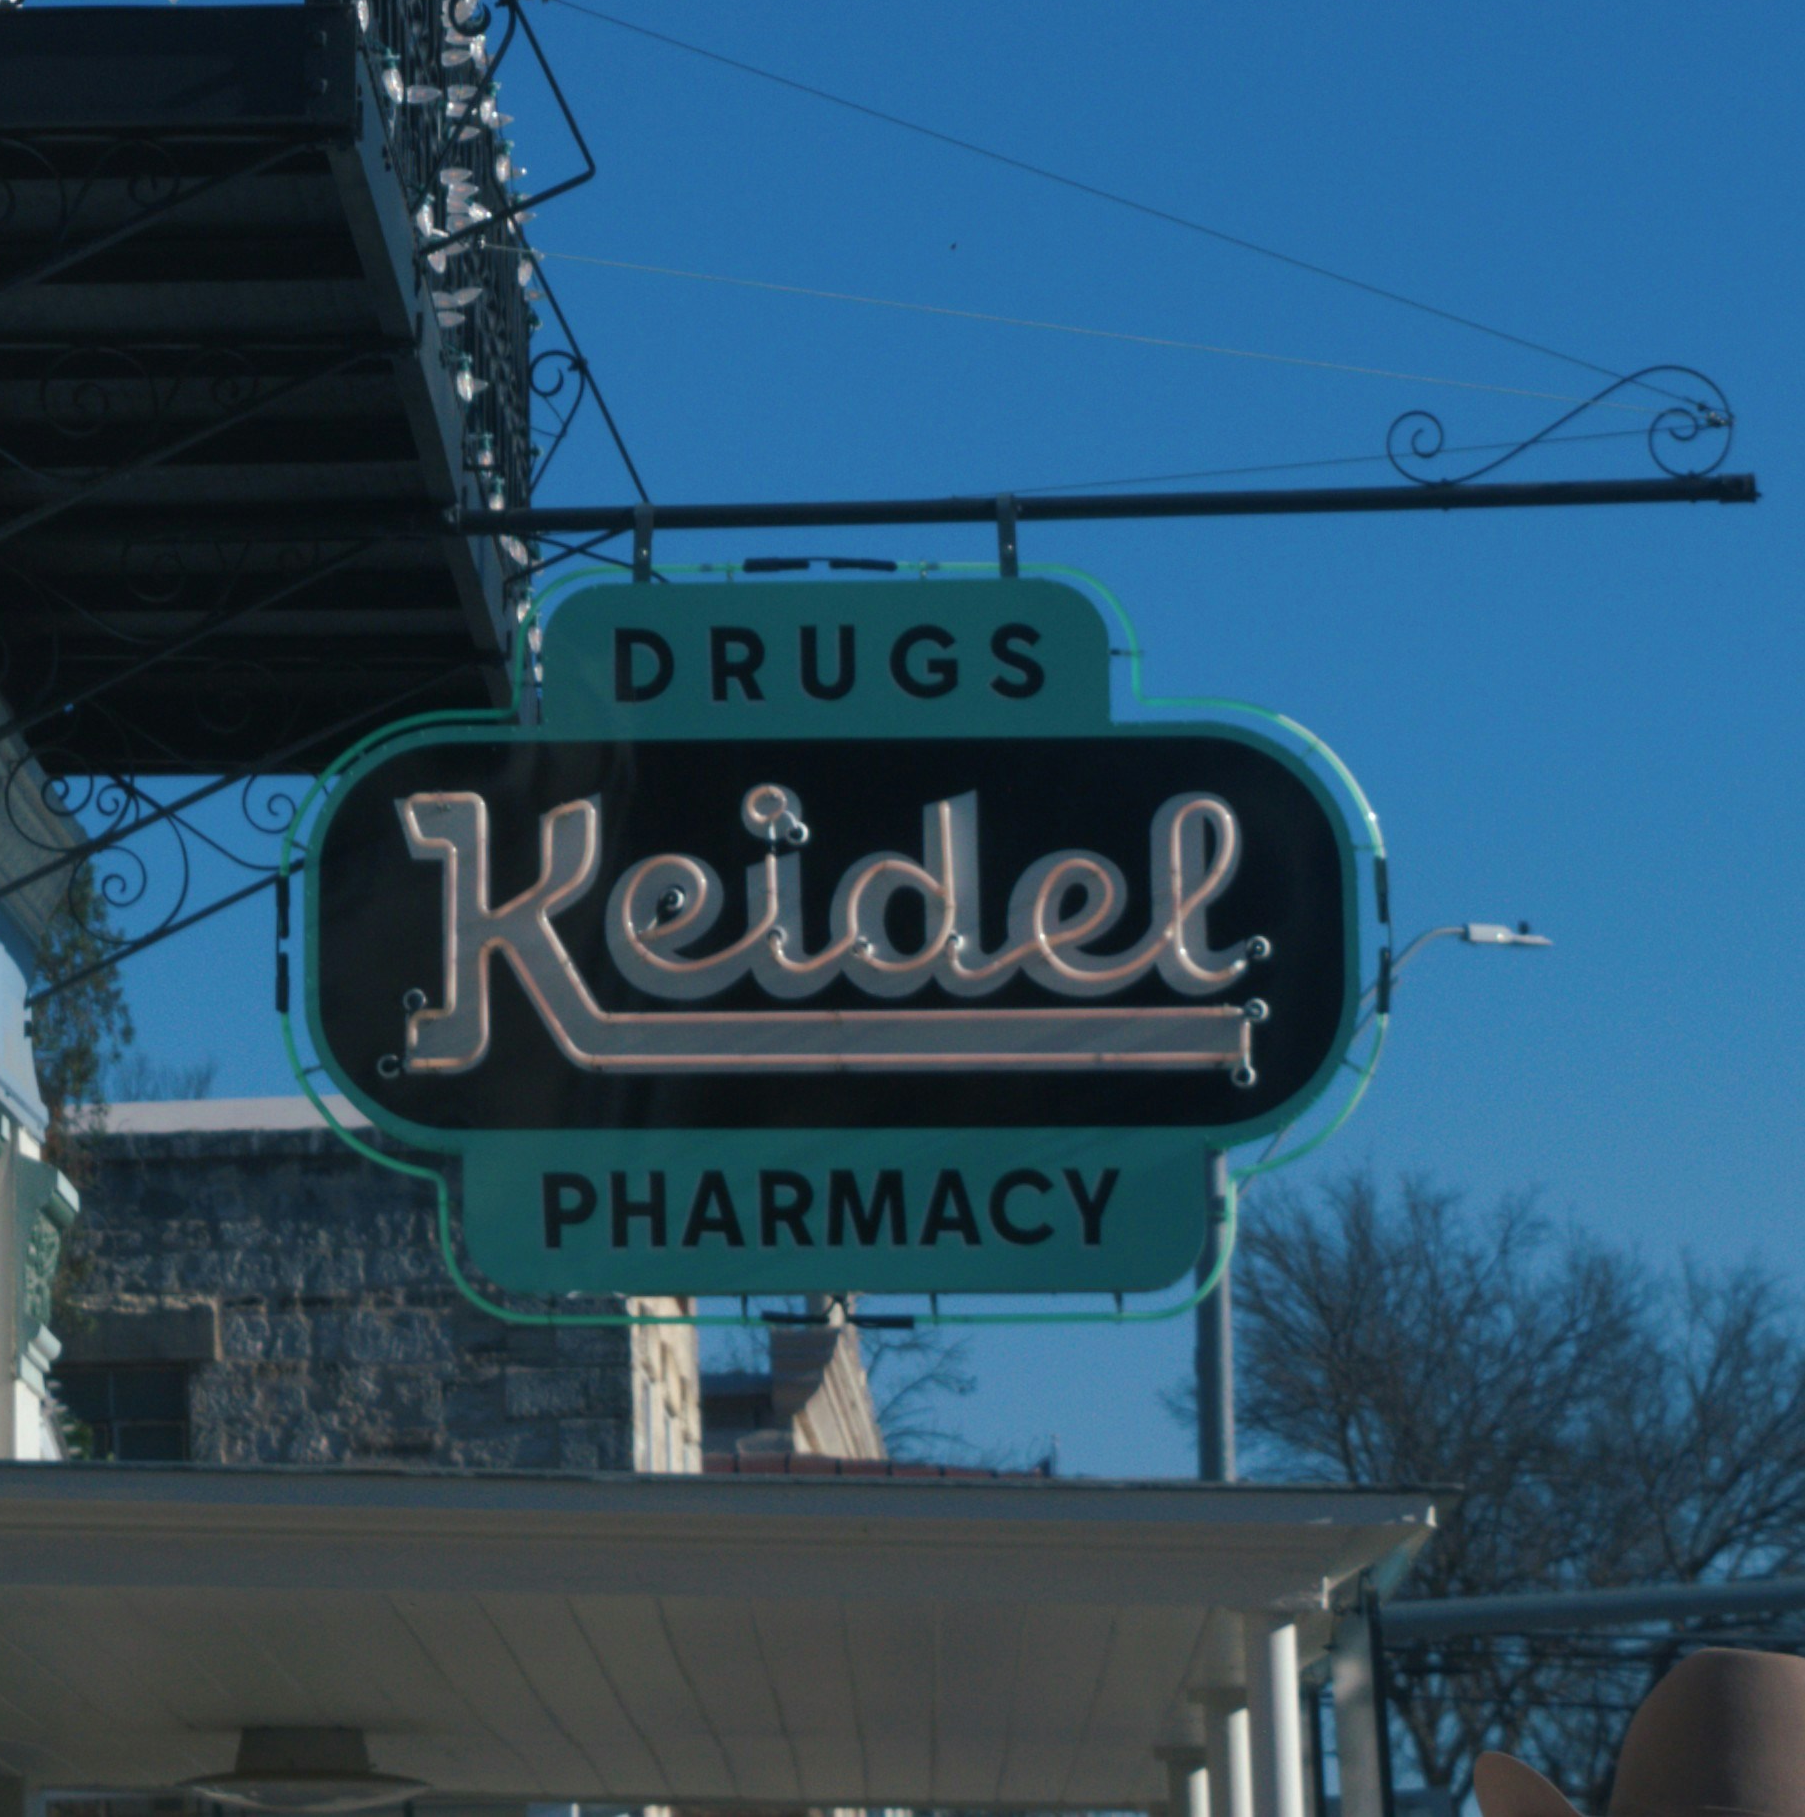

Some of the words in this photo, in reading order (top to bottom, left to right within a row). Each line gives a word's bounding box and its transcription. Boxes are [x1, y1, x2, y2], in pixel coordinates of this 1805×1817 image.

[613, 622, 1047, 704] DRUGS
[393, 783, 1252, 1075] Keidel
[541, 1167, 1122, 1250] PHARMACY
